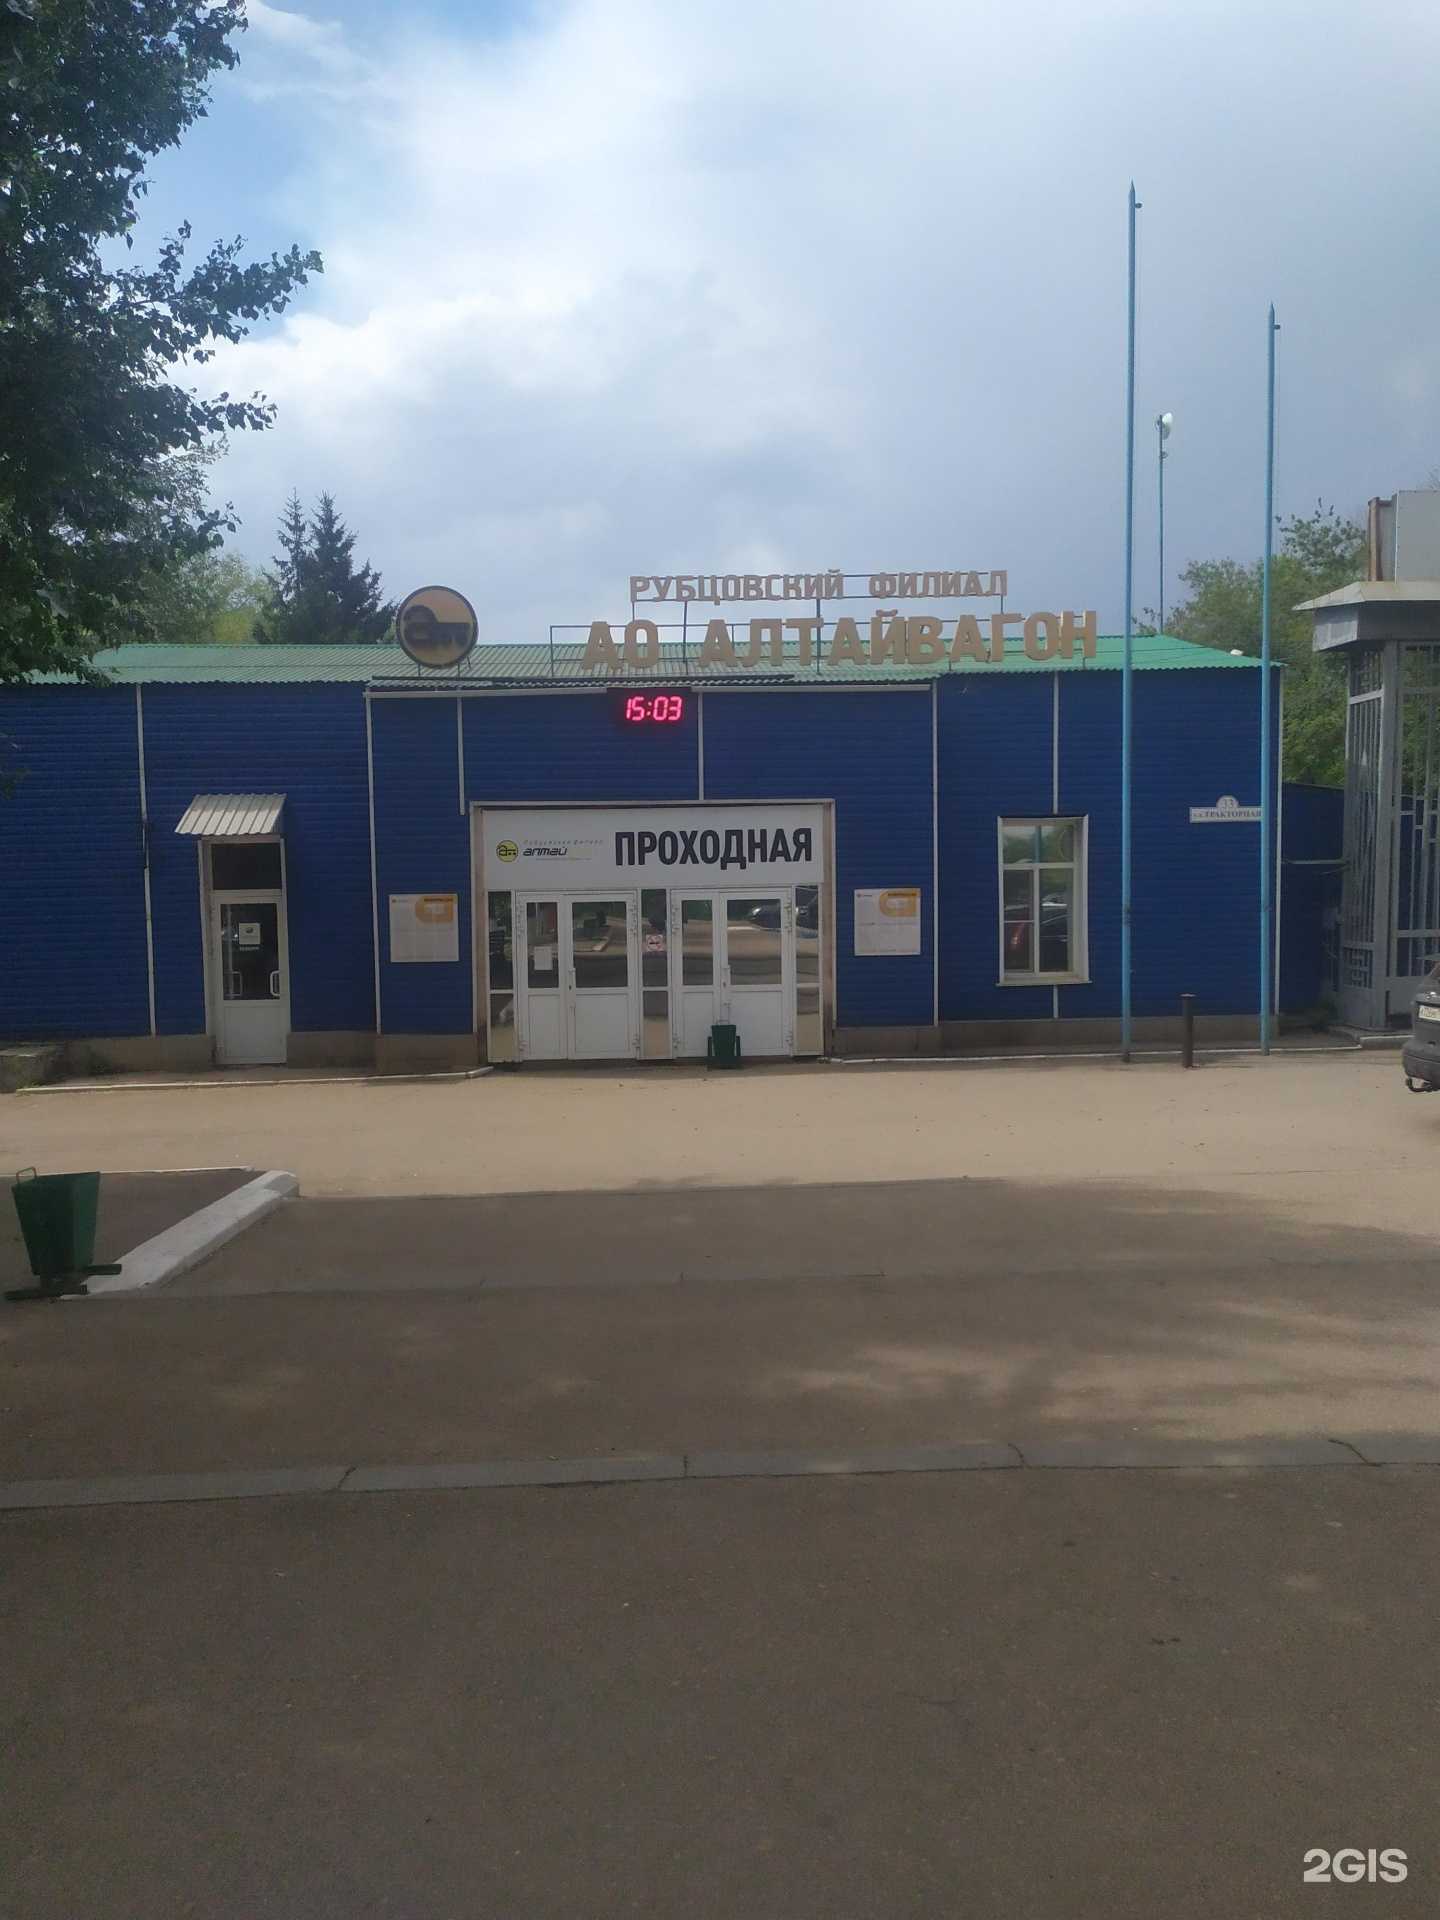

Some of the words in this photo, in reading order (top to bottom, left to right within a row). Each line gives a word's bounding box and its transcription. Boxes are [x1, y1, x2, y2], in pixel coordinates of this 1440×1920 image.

[629, 568, 844, 606] РУБЦОВСКИЙ
[868, 569, 1008, 600] ФИЛИАЛ
[581, 619, 660, 671] АО
[696, 609, 1097, 668] АЛТАЙВАГОН
[625, 696, 682, 721] 15:03
[615, 828, 812, 870] ПРОХОДНАЯ
